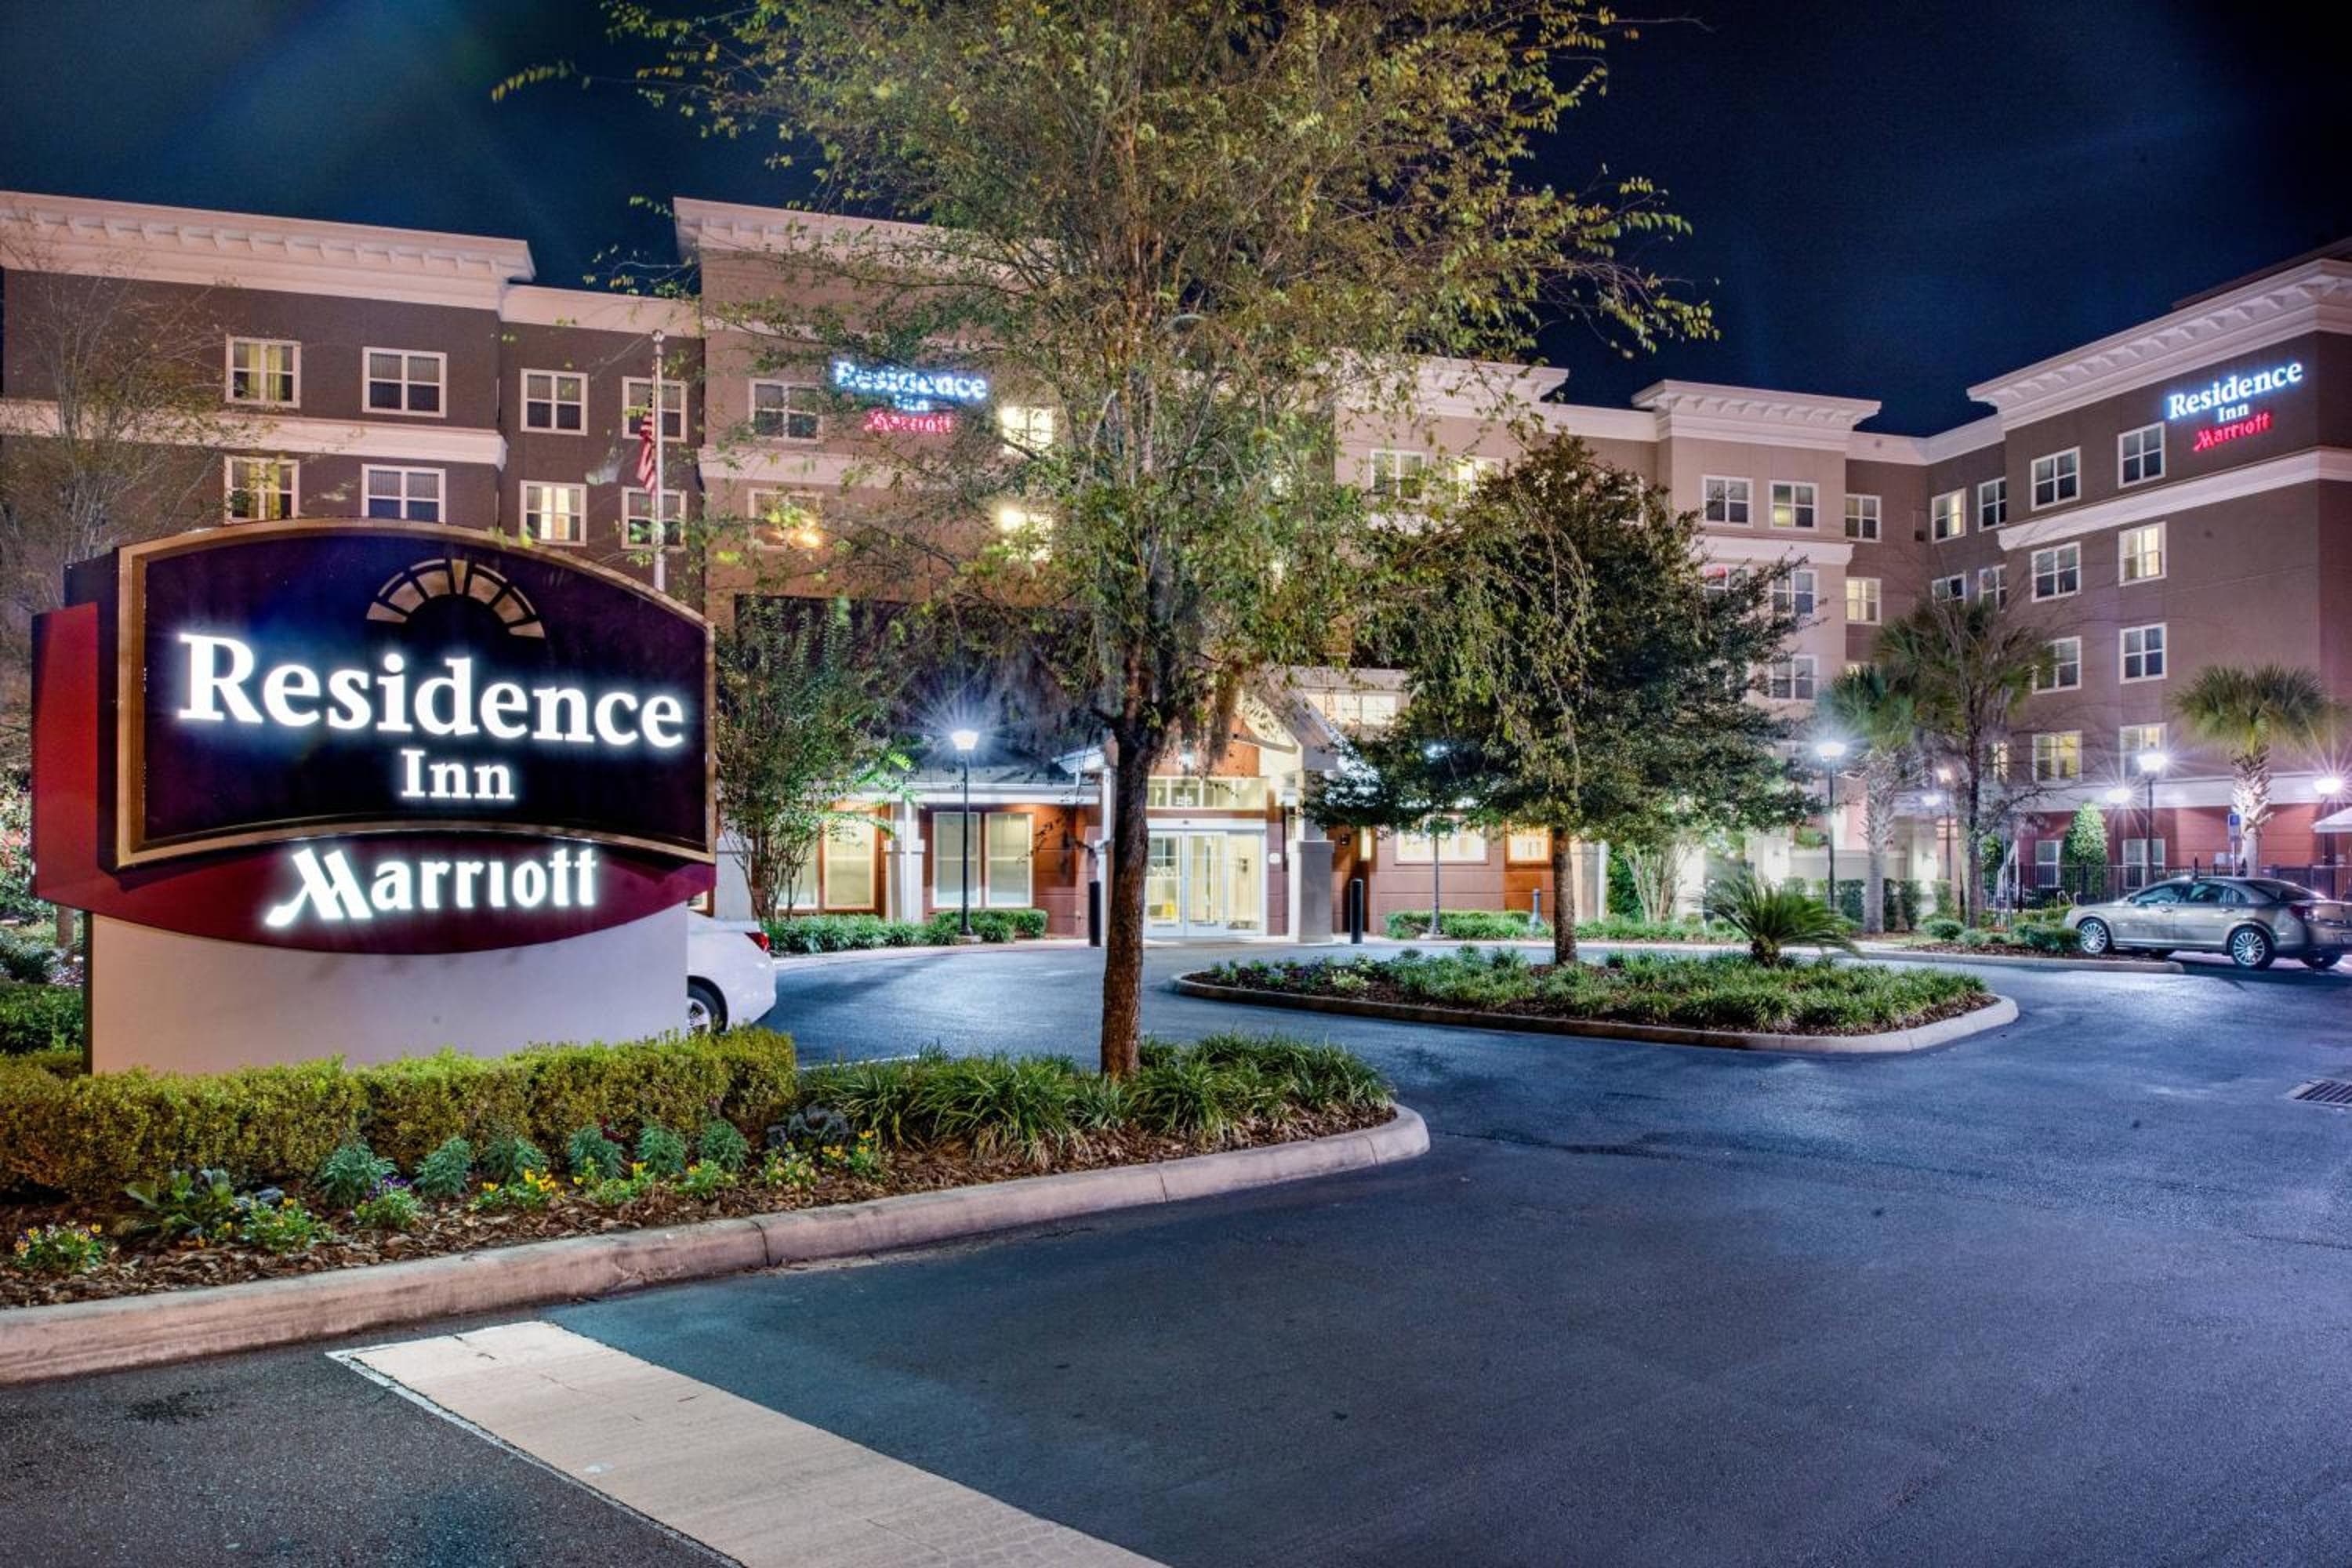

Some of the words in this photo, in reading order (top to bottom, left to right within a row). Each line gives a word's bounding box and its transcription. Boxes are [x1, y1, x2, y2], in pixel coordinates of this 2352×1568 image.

[2169, 362, 2303, 419] Residence
[2217, 402, 2249, 423] Inn
[2194, 412, 2272, 452] Marriott
[179, 633, 684, 747] Residence
[401, 750, 515, 800] Inn
[265, 848, 597, 927] Marriott
